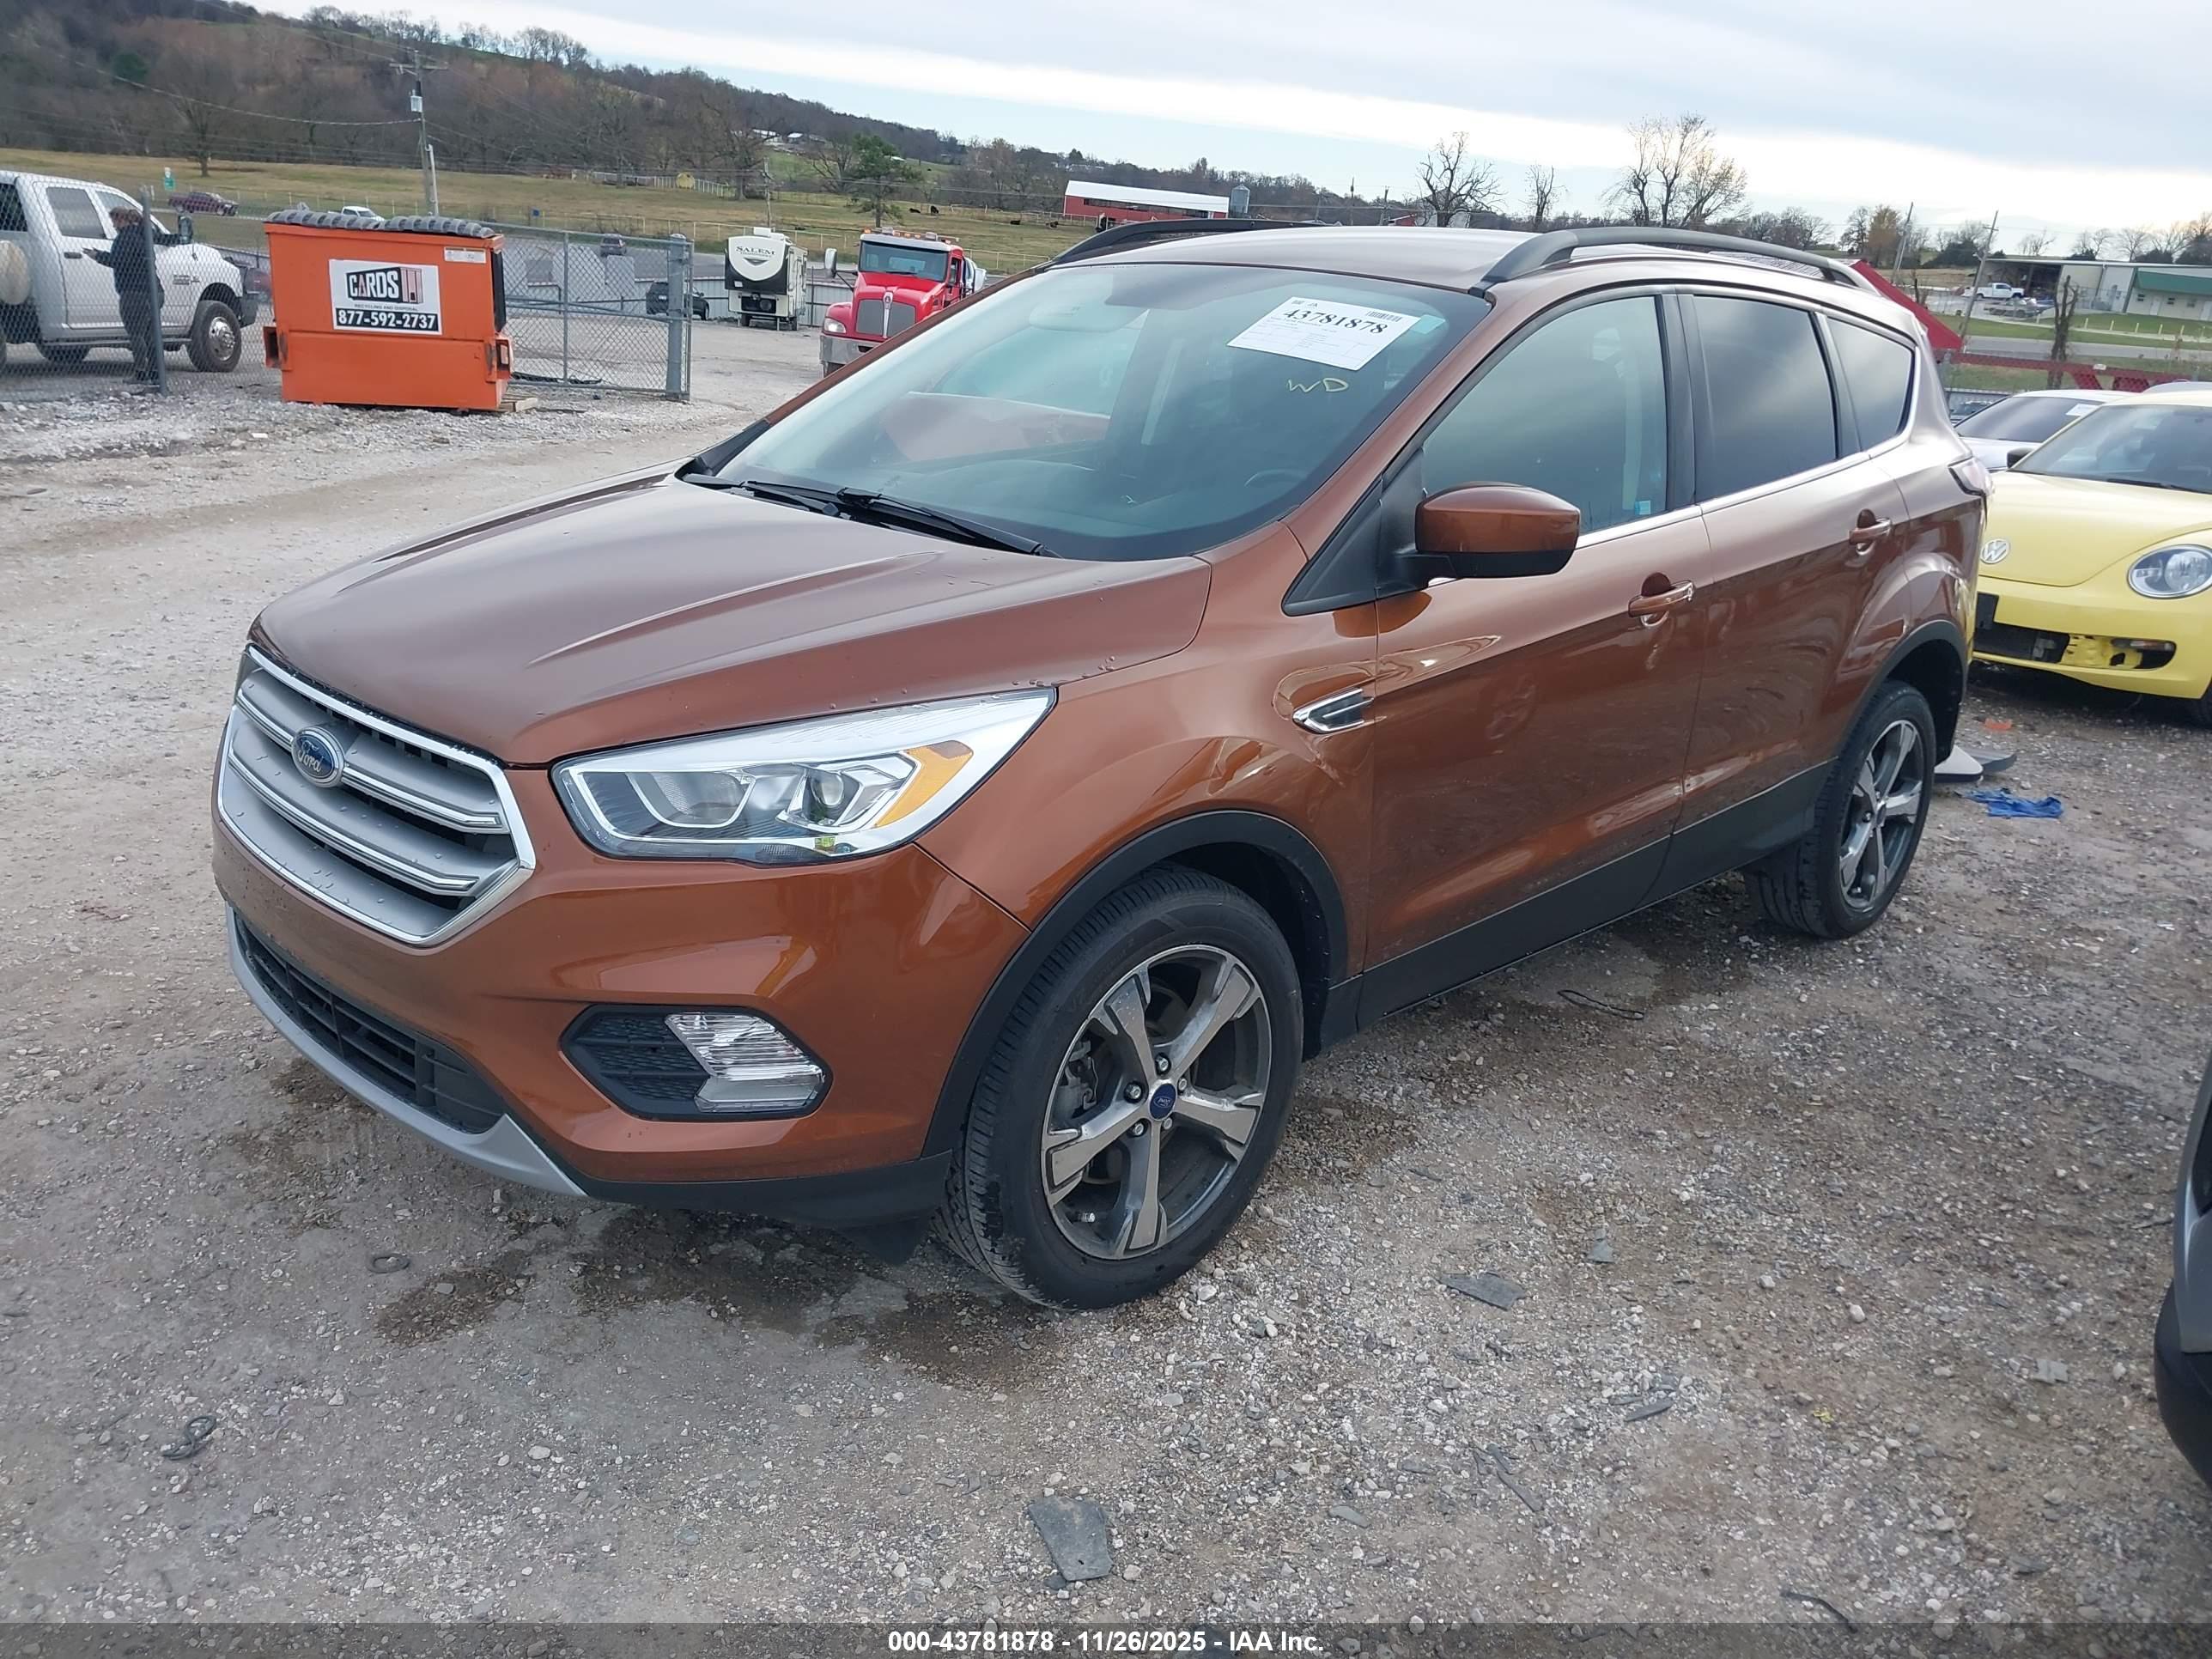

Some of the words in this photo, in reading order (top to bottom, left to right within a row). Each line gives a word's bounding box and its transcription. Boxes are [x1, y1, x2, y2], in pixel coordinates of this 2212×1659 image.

[736, 246, 775, 255] SALEM
[349, 270, 399, 299] CARDS
[338, 309, 435, 329] 877-592-2737
[1284, 309, 1389, 333] 43781878
[297, 739, 324, 772] Ford
